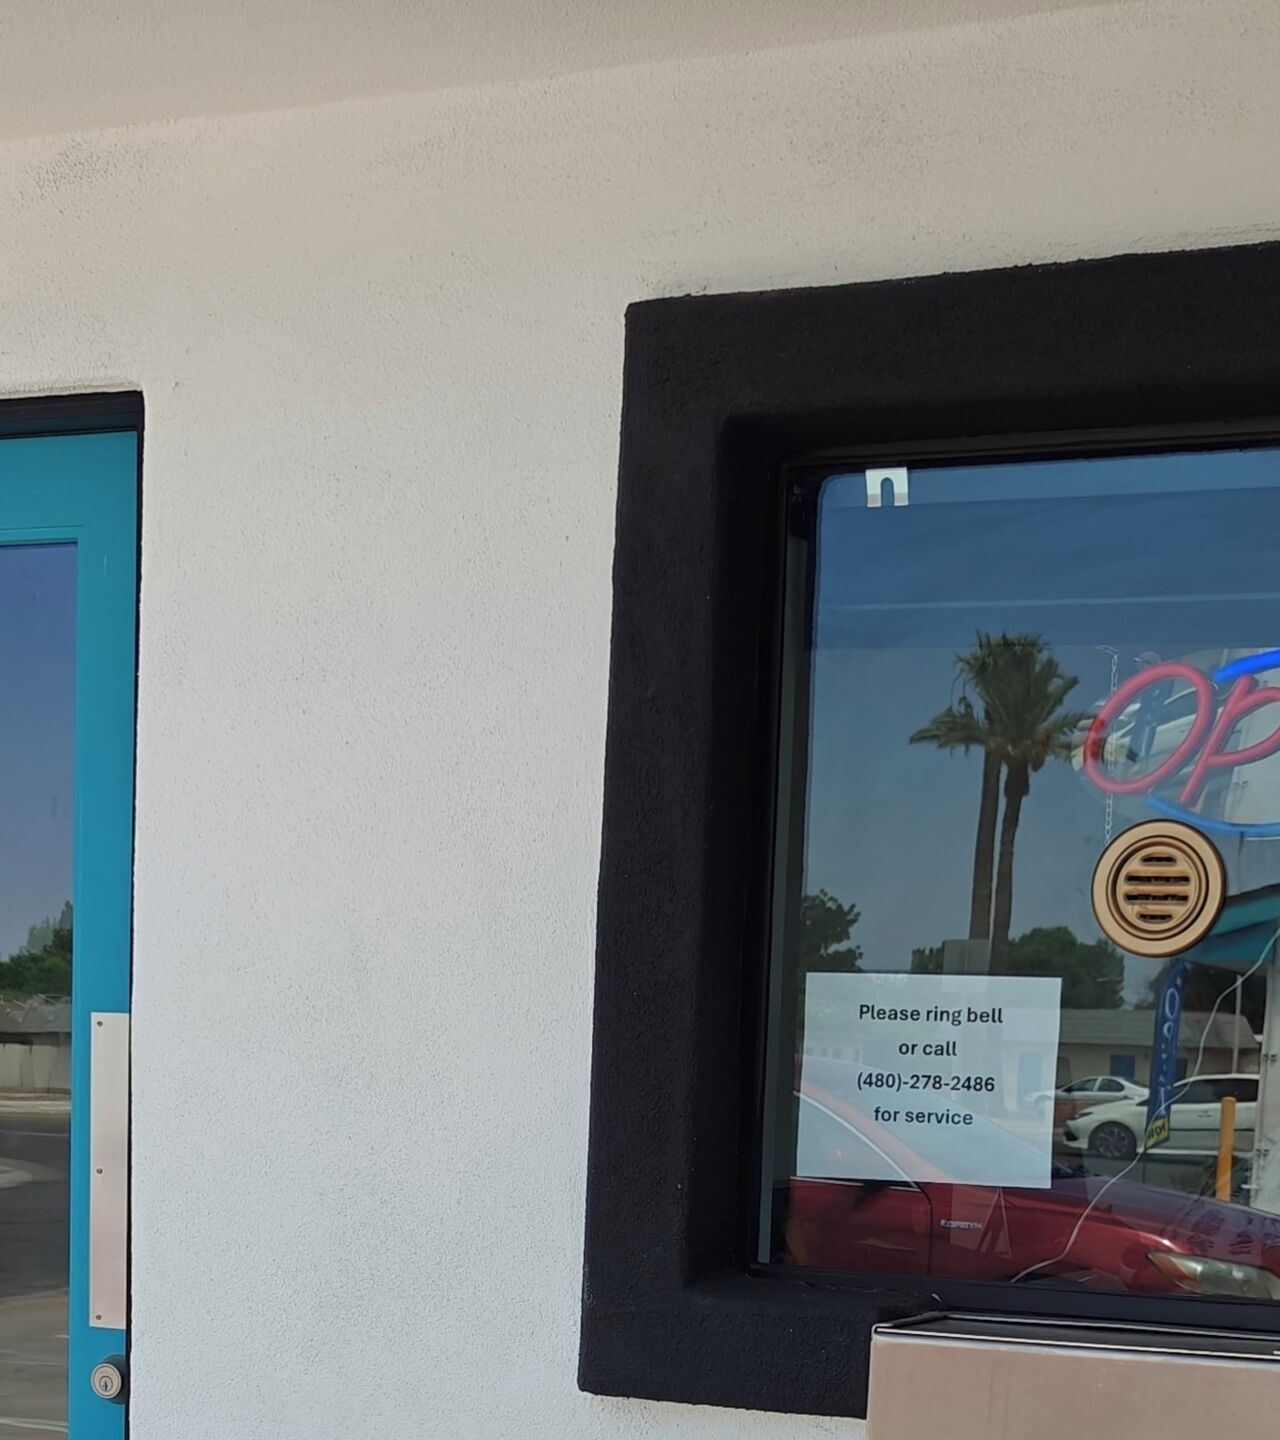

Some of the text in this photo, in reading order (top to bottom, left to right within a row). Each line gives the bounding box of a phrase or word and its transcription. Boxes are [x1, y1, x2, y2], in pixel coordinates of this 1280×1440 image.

[858, 1004, 1004, 1027] Please ring bell
[898, 1041, 958, 1057] or call
[856, 1071, 996, 1093] (480)-278-2486
[873, 1106, 974, 1126] for service
